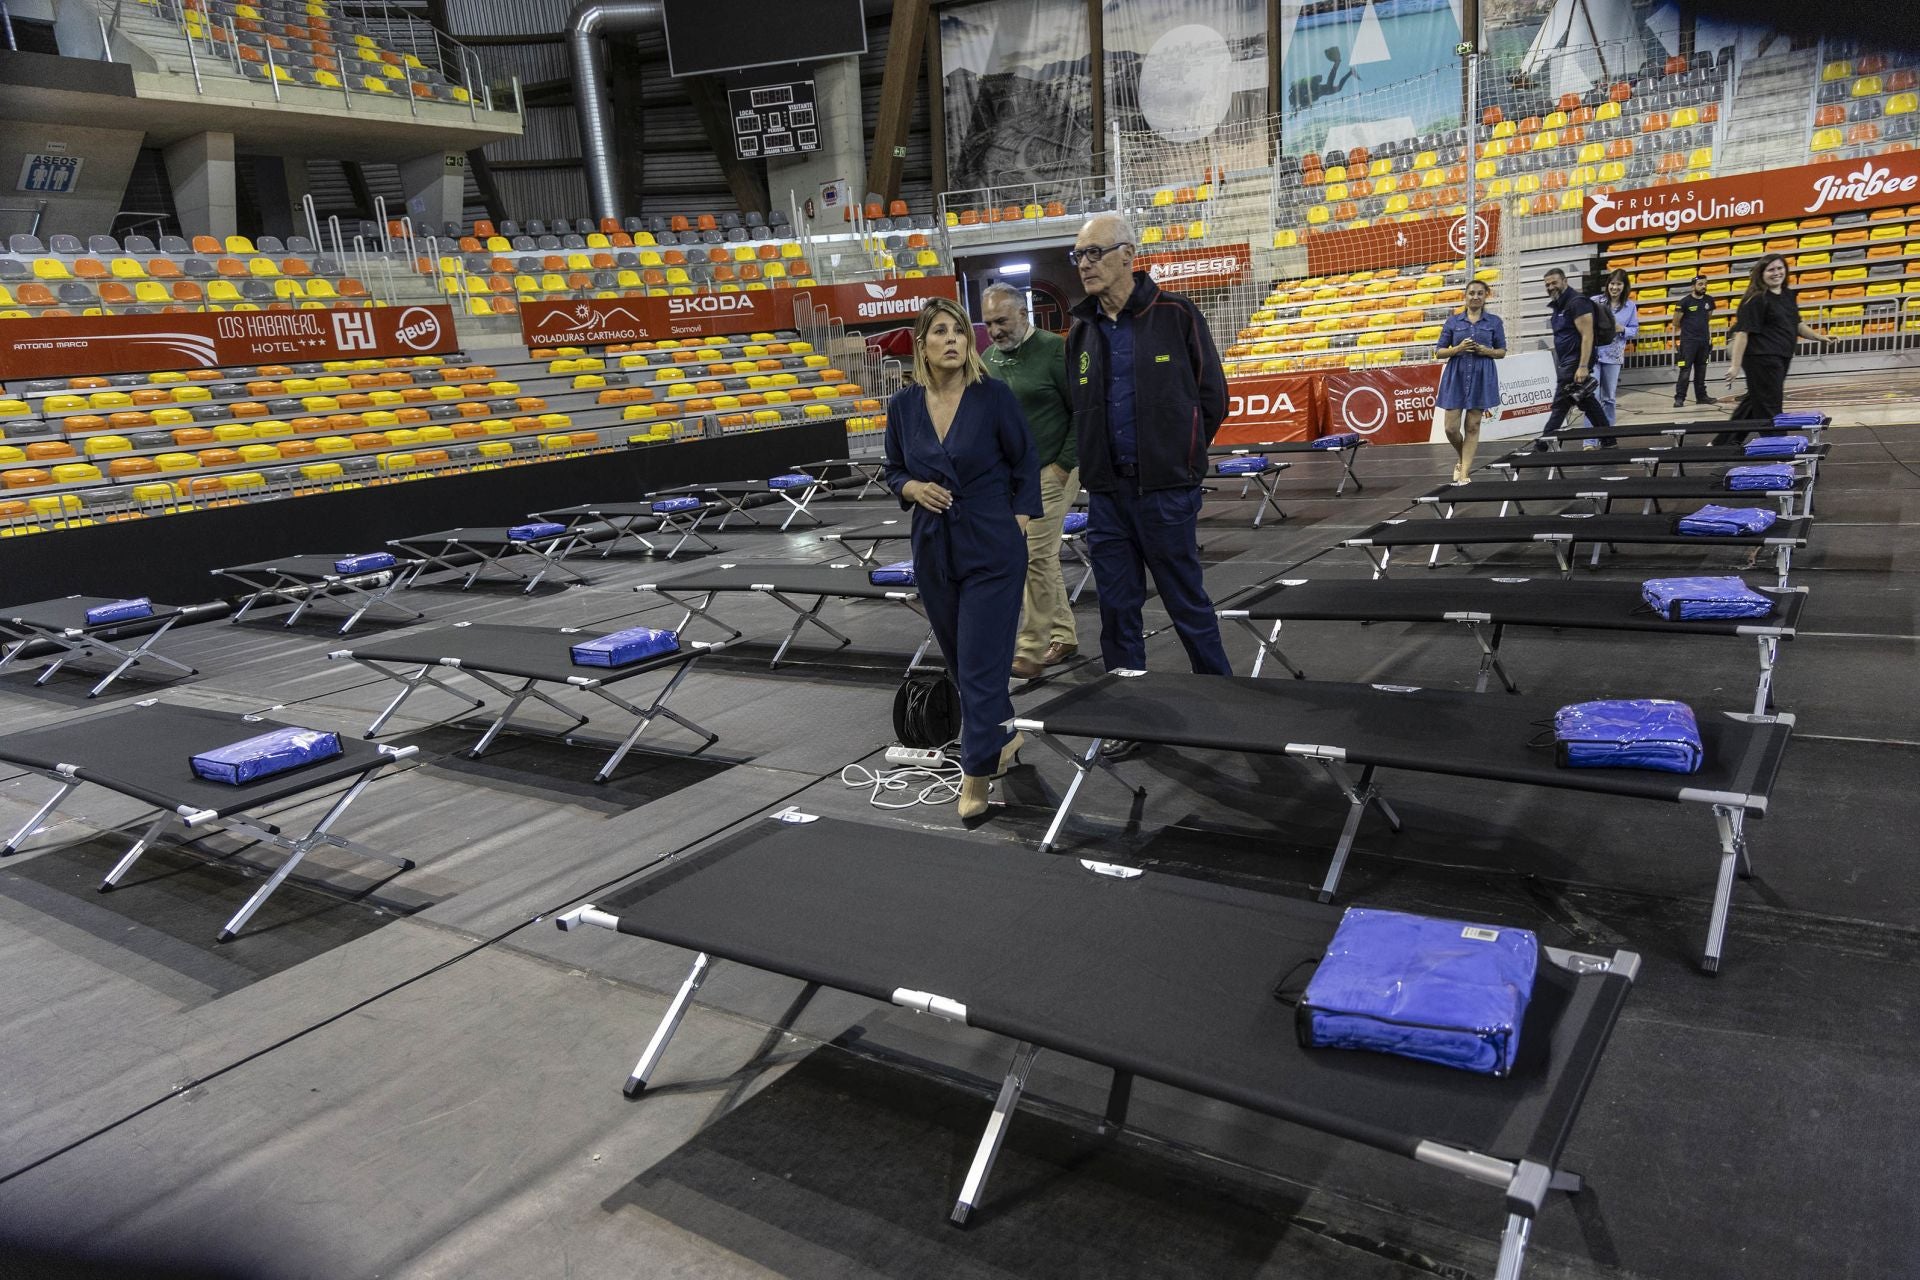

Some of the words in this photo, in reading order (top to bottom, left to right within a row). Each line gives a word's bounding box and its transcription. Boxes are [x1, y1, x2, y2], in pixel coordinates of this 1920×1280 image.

[739, 109, 755, 117] LOCAL
[788, 103, 813, 111] VISITANTE
[33, 155, 78, 166] ASEOS
[1804, 162, 1918, 213] Jimbee
[1617, 190, 1695, 210] FRUTAS
[1150, 256, 1237, 279] MASEGO
[217, 316, 245, 339] LOS
[532, 332, 585, 344] VOLADURAS
[587, 330, 638, 341] CARTHAGO,
[639, 328, 649, 338] SL
[14, 342, 53, 350] ANTONIO
[251, 341, 299, 353] HOTEL
[1499, 376, 1549, 392] Ayuntamiento
[1228, 392, 1296, 416] ODA
[1394, 394, 1436, 411] REGIÓ
[1500, 388, 1553, 406] Cartagena
[1396, 411, 1414, 424] DE
